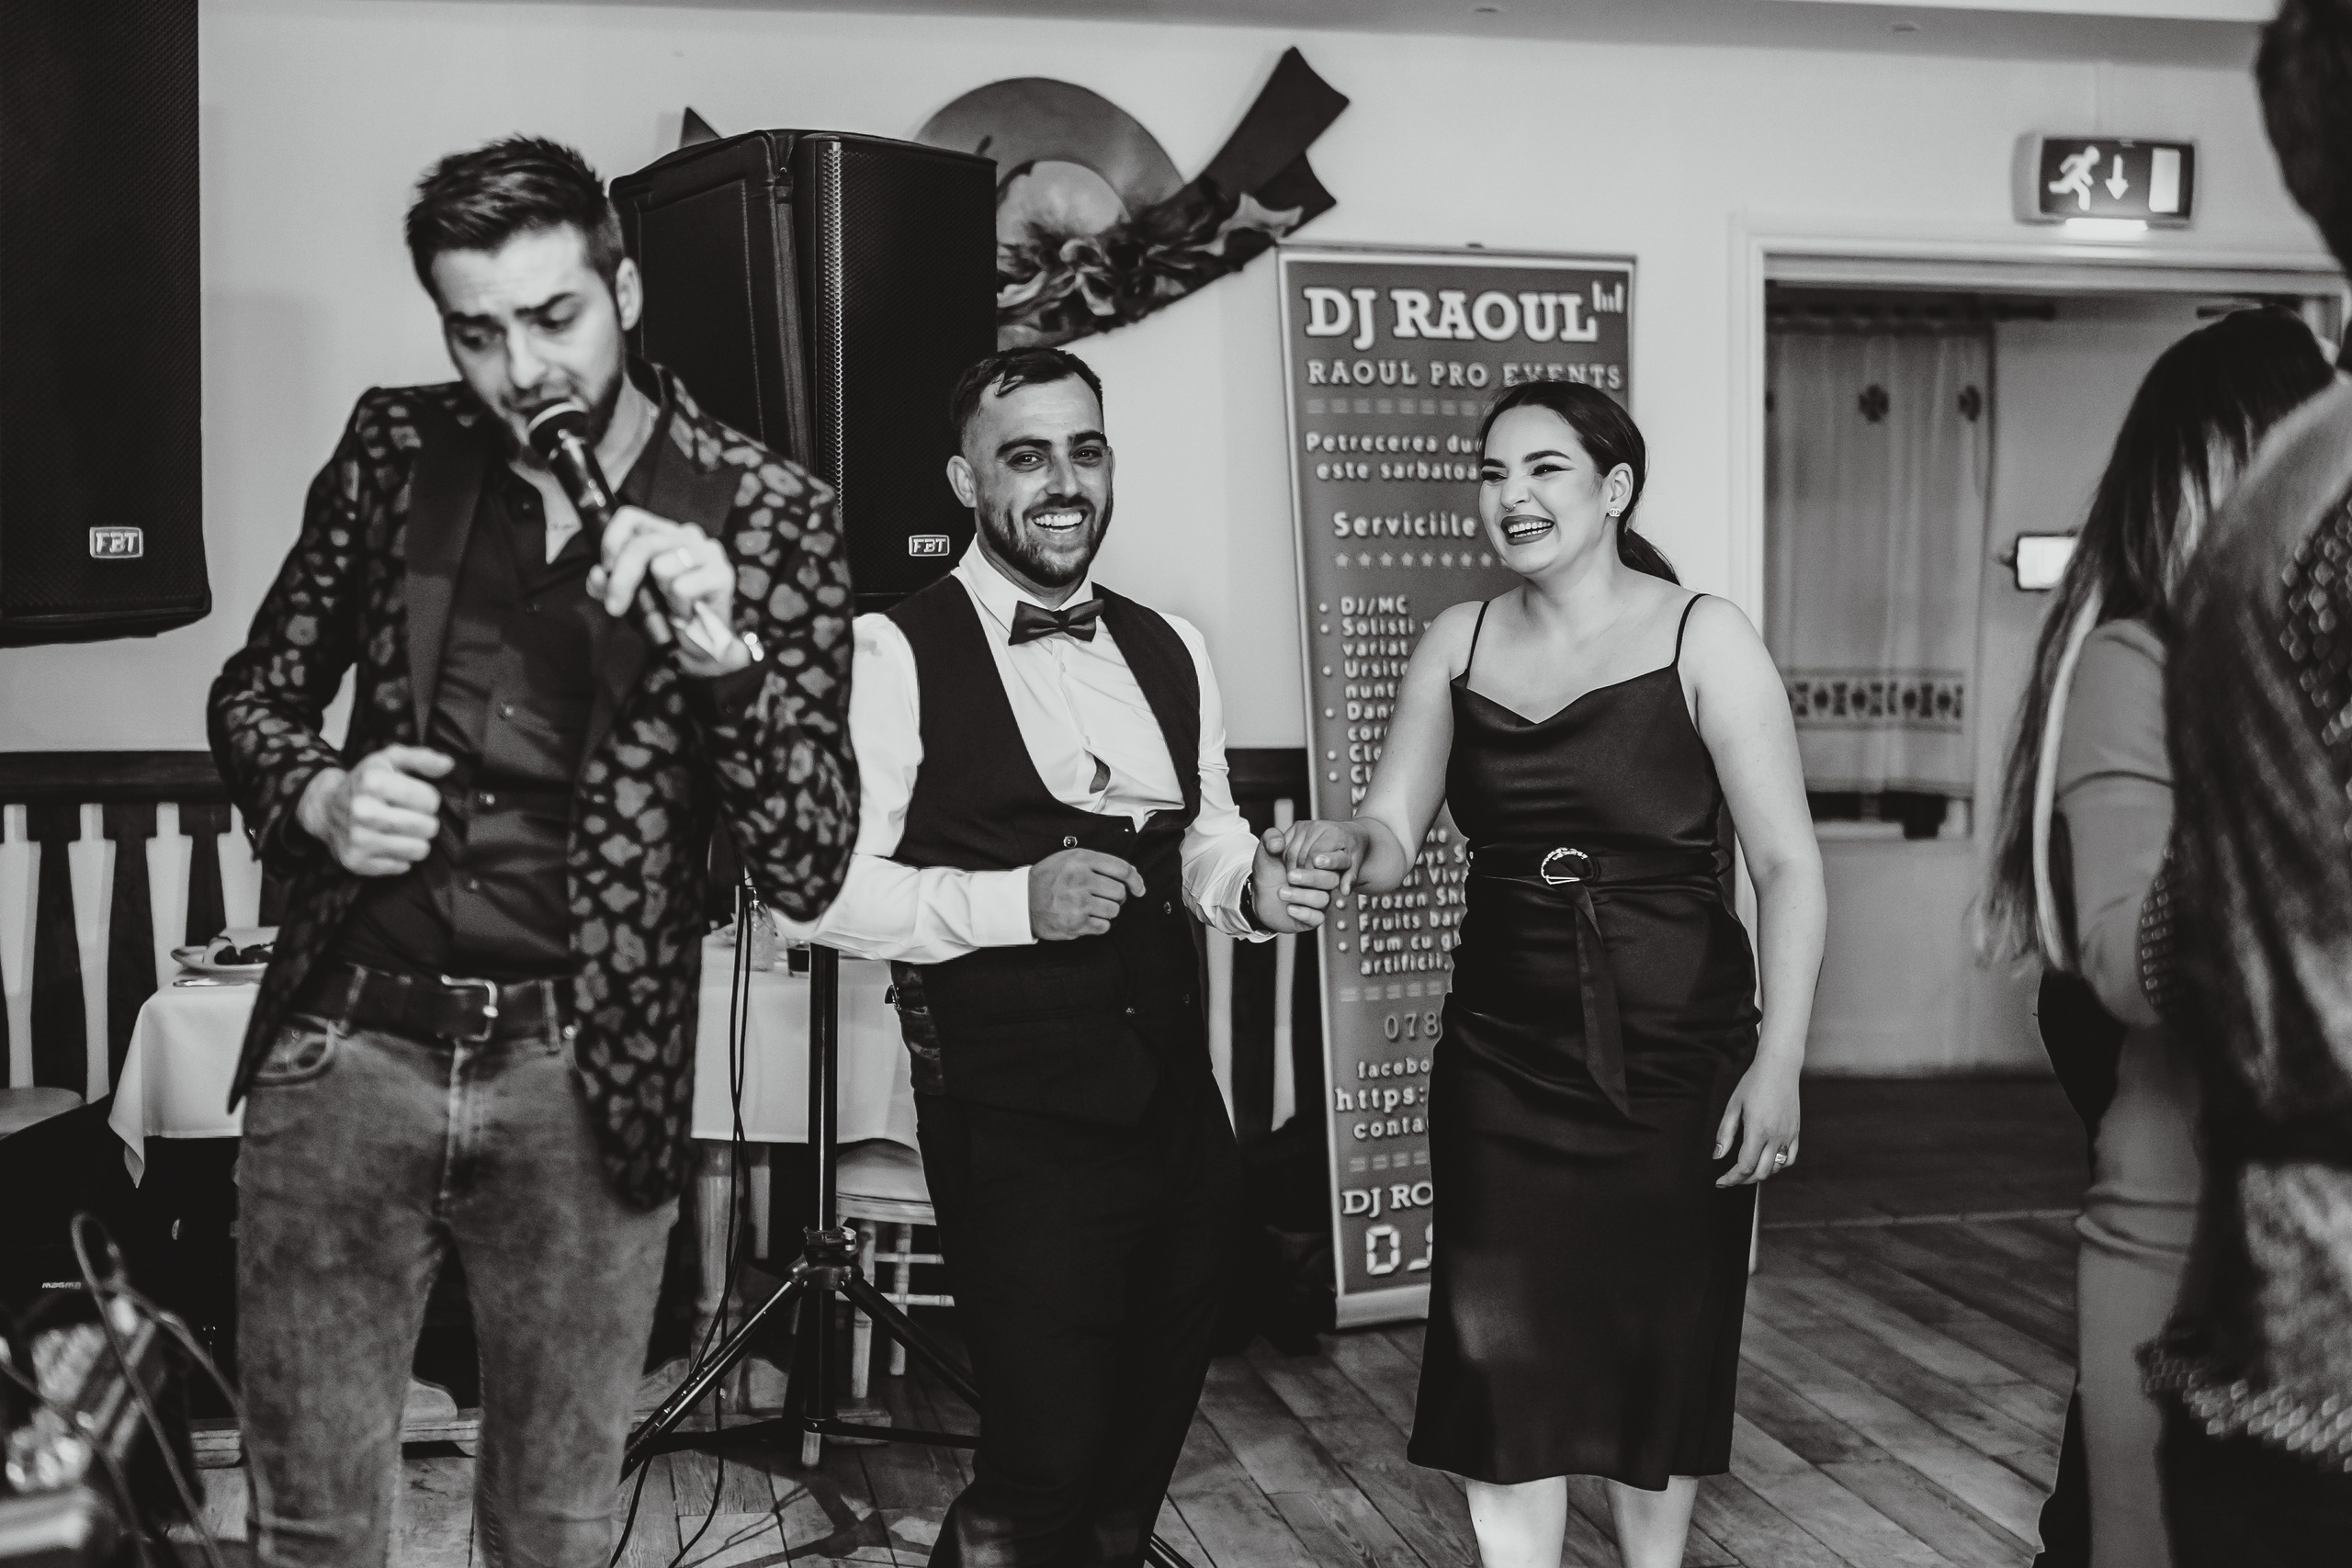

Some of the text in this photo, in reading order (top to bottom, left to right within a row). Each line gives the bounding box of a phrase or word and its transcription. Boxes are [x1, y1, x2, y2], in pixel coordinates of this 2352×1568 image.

[1304, 288, 1598, 351] DJ RAOUL
[1308, 359, 1622, 389] RAOUL PRO EVENTS
[1306, 432, 1438, 452] Petrecerea
[1317, 463, 1369, 479] este
[1333, 511, 1477, 537] Serviciile
[96, 531, 139, 553] FBT
[913, 538, 946, 553] FBT
[1384, 1012, 1438, 1040] 078
[1353, 1116, 1430, 1139] conta
[1341, 1181, 1433, 1218] DJ RO
